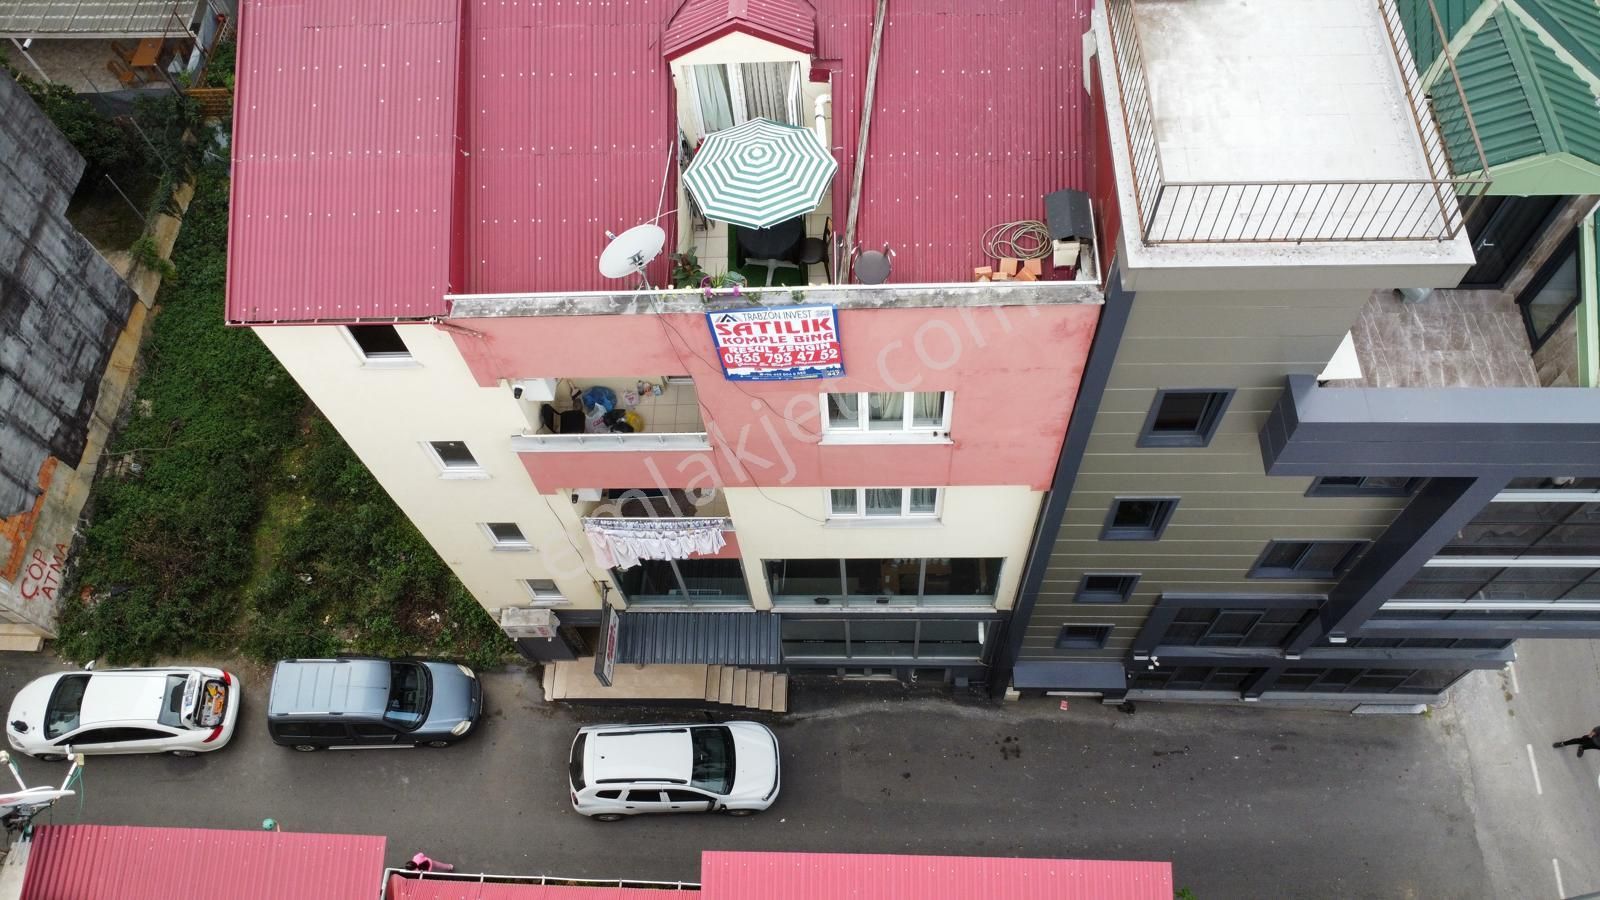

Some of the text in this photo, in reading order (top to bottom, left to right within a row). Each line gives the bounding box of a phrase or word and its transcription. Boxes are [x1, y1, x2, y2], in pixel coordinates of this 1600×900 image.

[743, 312, 782, 321] TRABZON
[783, 310, 812, 319] INVEST
[715, 317, 833, 336] SATILIK
[722, 335, 787, 345] KOMPLE
[724, 348, 838, 364] 0535 793 47 52
[728, 345, 774, 354] RESUL
[20, 548, 48, 600] ÇÖP
[41, 543, 67, 601] ATMA
